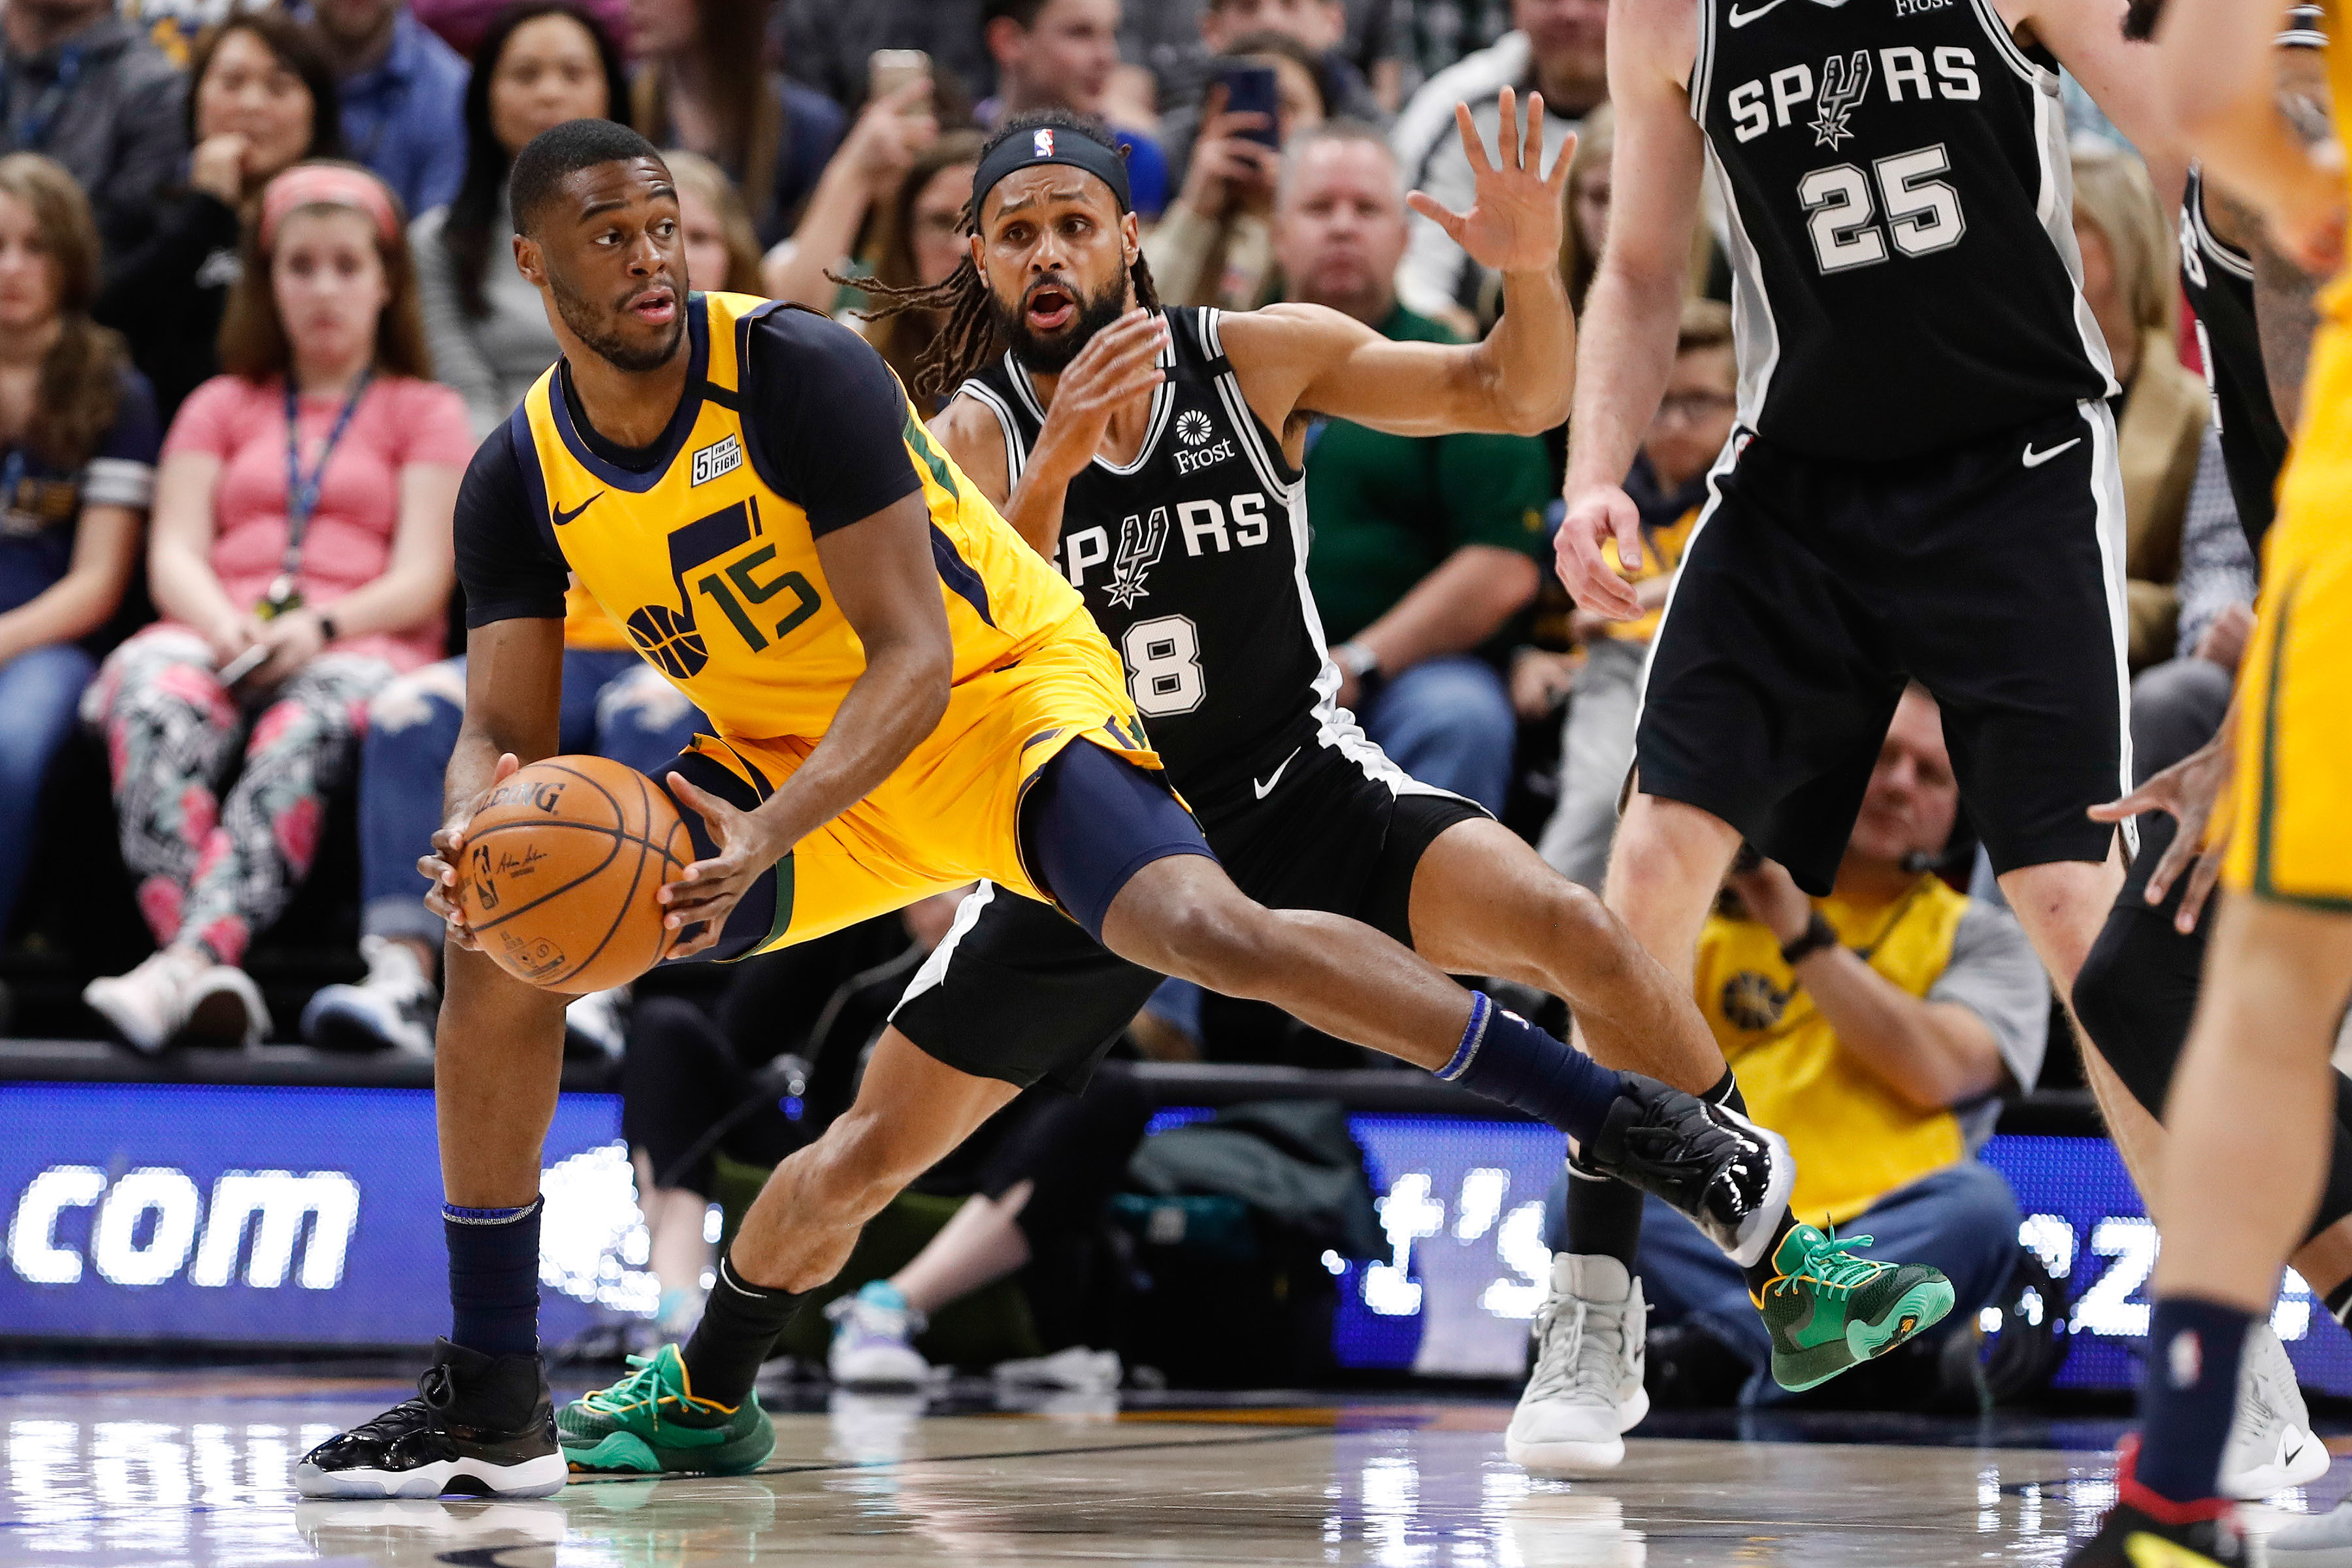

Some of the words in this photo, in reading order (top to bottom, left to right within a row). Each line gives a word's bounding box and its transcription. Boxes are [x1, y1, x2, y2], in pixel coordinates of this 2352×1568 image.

[1896, 0, 1953, 17] Fros
[1728, 46, 1981, 152] SPURS
[1797, 142, 1967, 275] 25
[696, 451, 708, 480] 5
[715, 444, 725, 455] FOR
[715, 451, 739, 474] FIGHT
[1173, 438, 1235, 475] Frost
[1052, 493, 1269, 610] PURS
[698, 542, 822, 654] 15
[1121, 613, 1207, 718] 8
[476, 782, 566, 813] LDING
[7, 1165, 360, 1290] com
